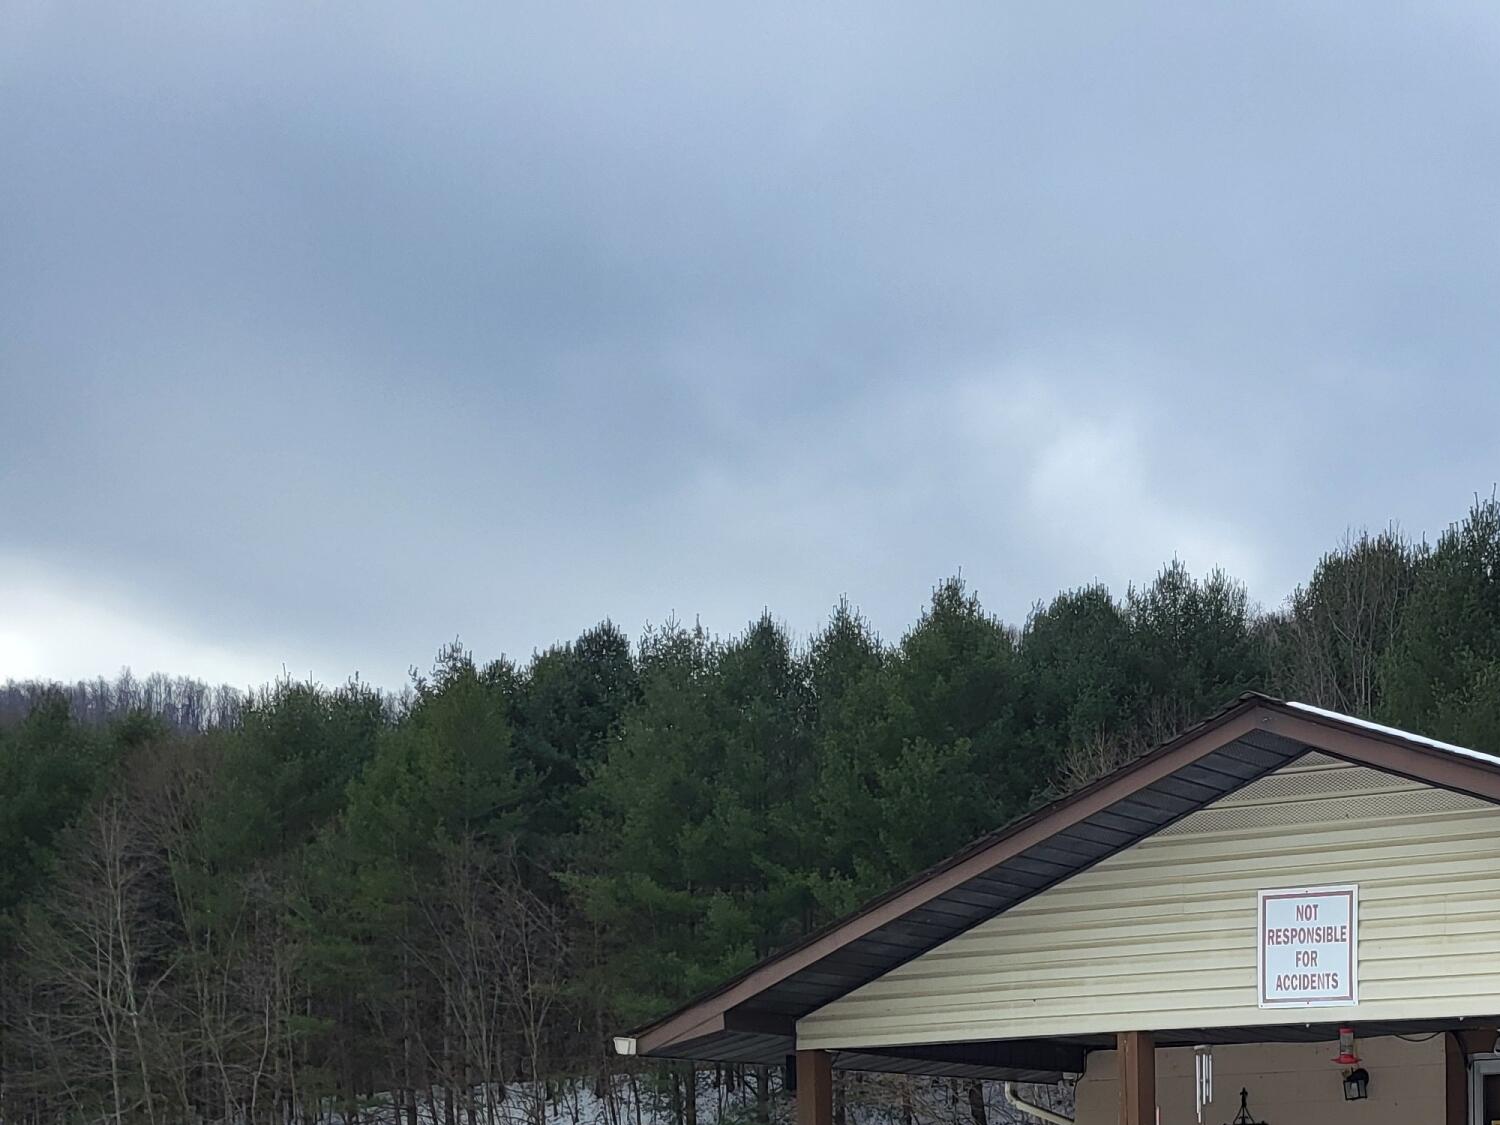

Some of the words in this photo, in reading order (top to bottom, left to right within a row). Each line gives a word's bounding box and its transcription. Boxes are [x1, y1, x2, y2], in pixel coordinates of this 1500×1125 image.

[1296, 904, 1319, 922] NOT
[1267, 925, 1347, 945] RESPONSIBLE
[1295, 950, 1318, 968] FOR
[1275, 972, 1339, 991] ACCIDENTS
